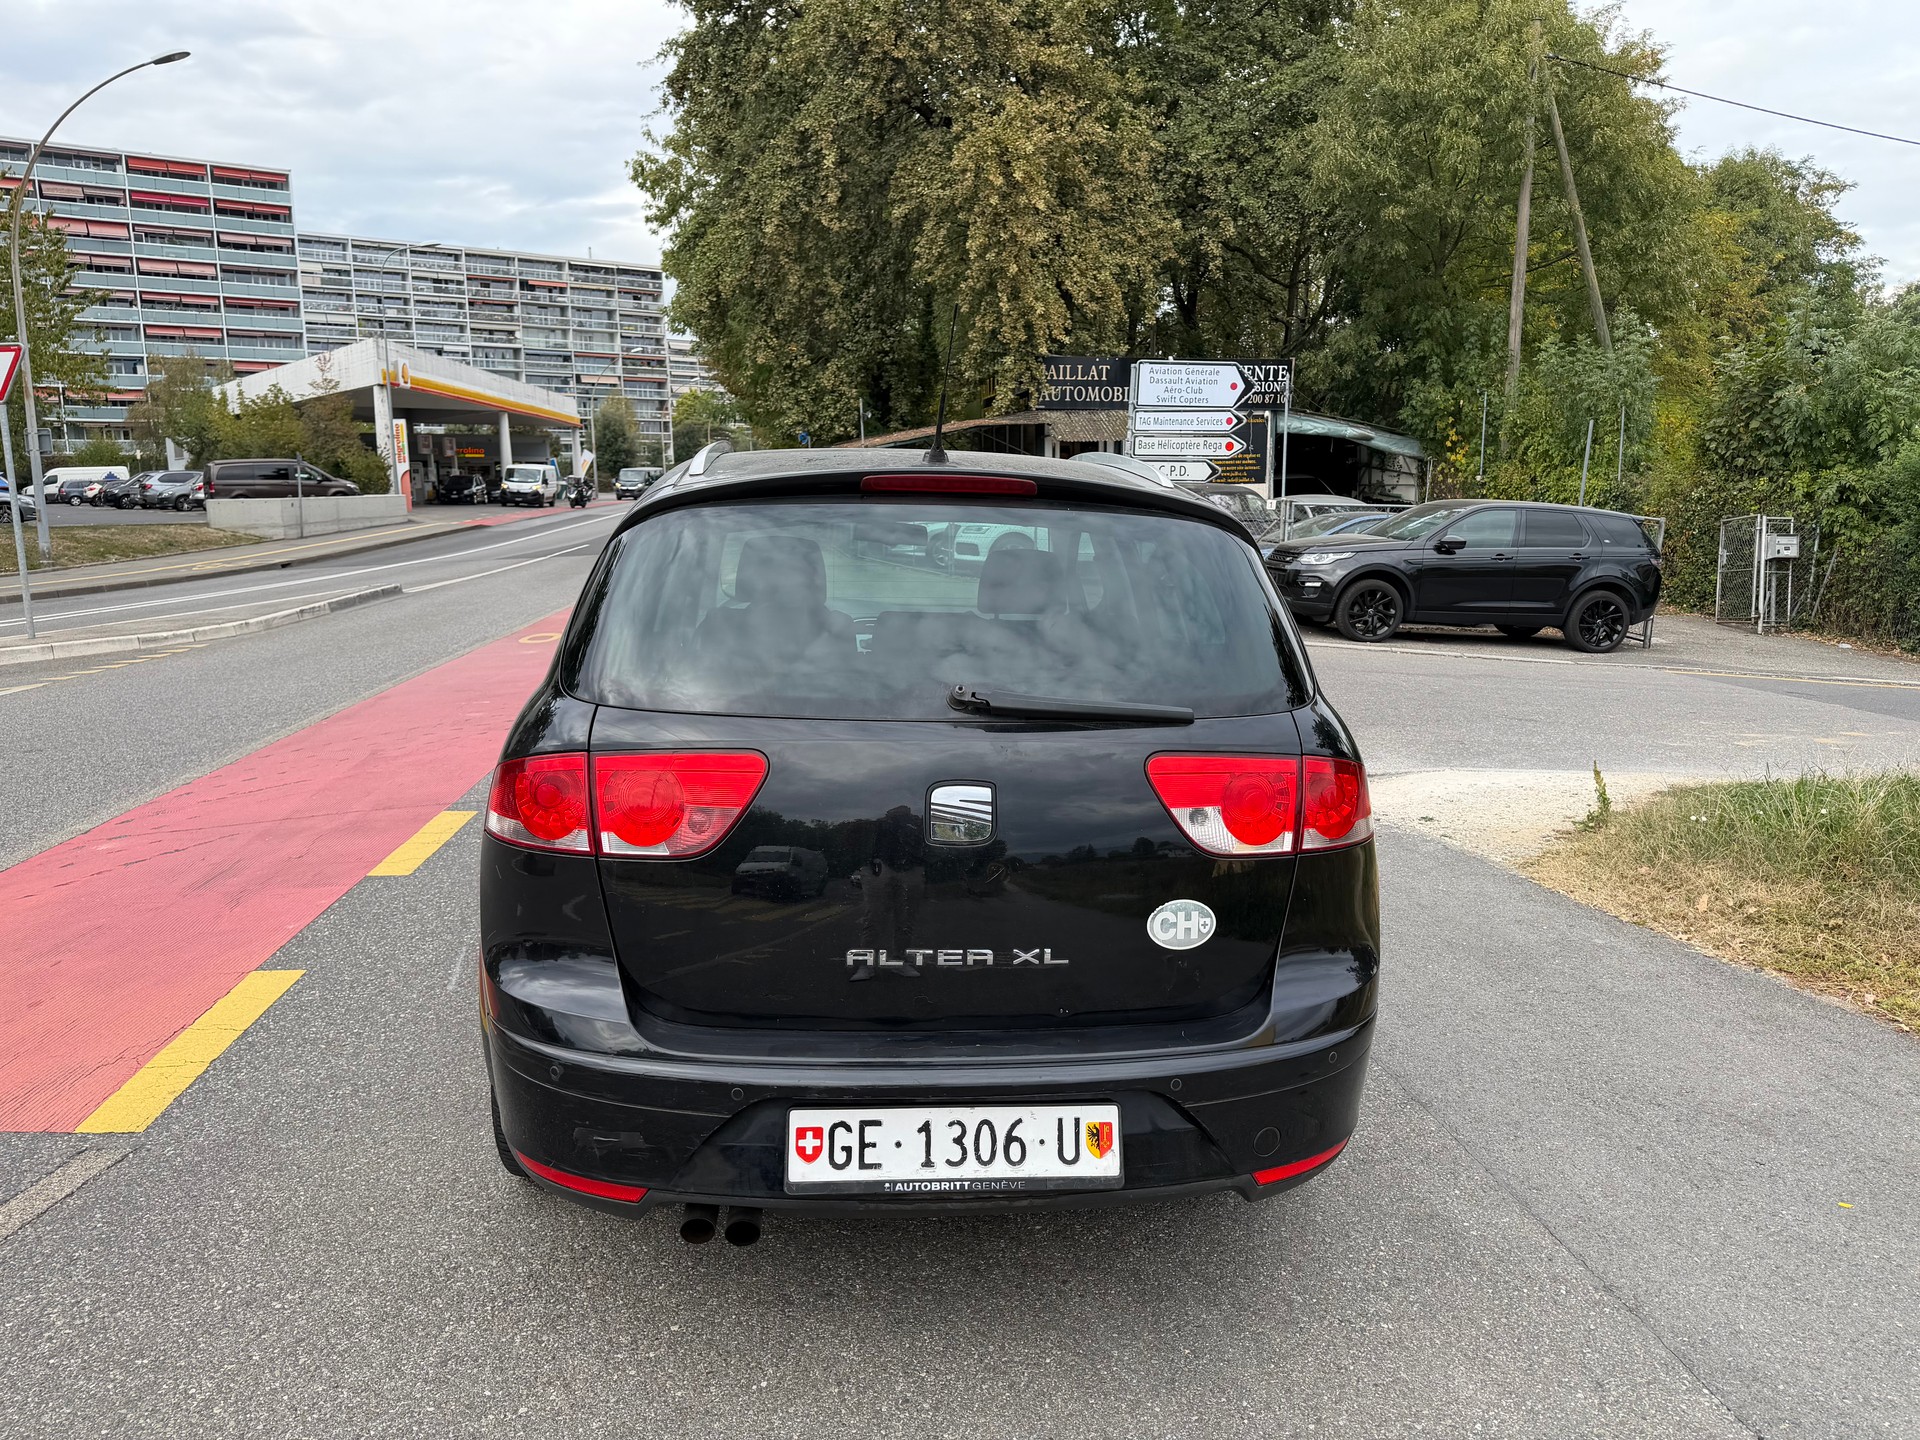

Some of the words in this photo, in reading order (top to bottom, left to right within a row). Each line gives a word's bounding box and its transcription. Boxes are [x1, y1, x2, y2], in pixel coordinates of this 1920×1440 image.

[1149, 367, 1182, 375] Aviation
[1185, 367, 1220, 376] Générale
[1240, 365, 1288, 381] ENTE
[1149, 376, 1183, 385] Dassault
[1185, 377, 1218, 386] Aviation
[1163, 386, 1203, 395] Aéro-Club
[1156, 395, 1174, 403] Swift
[1176, 396, 1209, 405] Copters
[1248, 394, 1263, 404] 200
[1264, 394, 1275, 404] 87
[1139, 417, 1151, 426] TAG
[1153, 417, 1194, 426] Maintenance
[1196, 417, 1223, 426] Services
[1138, 440, 1155, 449] Base
[1157, 440, 1201, 452] Hélicoptère
[1203, 441, 1222, 453] Rega
[1153, 911, 1198, 940] CH
[846, 949, 994, 966] ALTEA
[1013, 948, 1069, 965] XL
[916, 1118, 1027, 1169] 1306
[895, 1181, 970, 1192] AUTOBRITT
[972, 1180, 1026, 1190] GENÈVE
